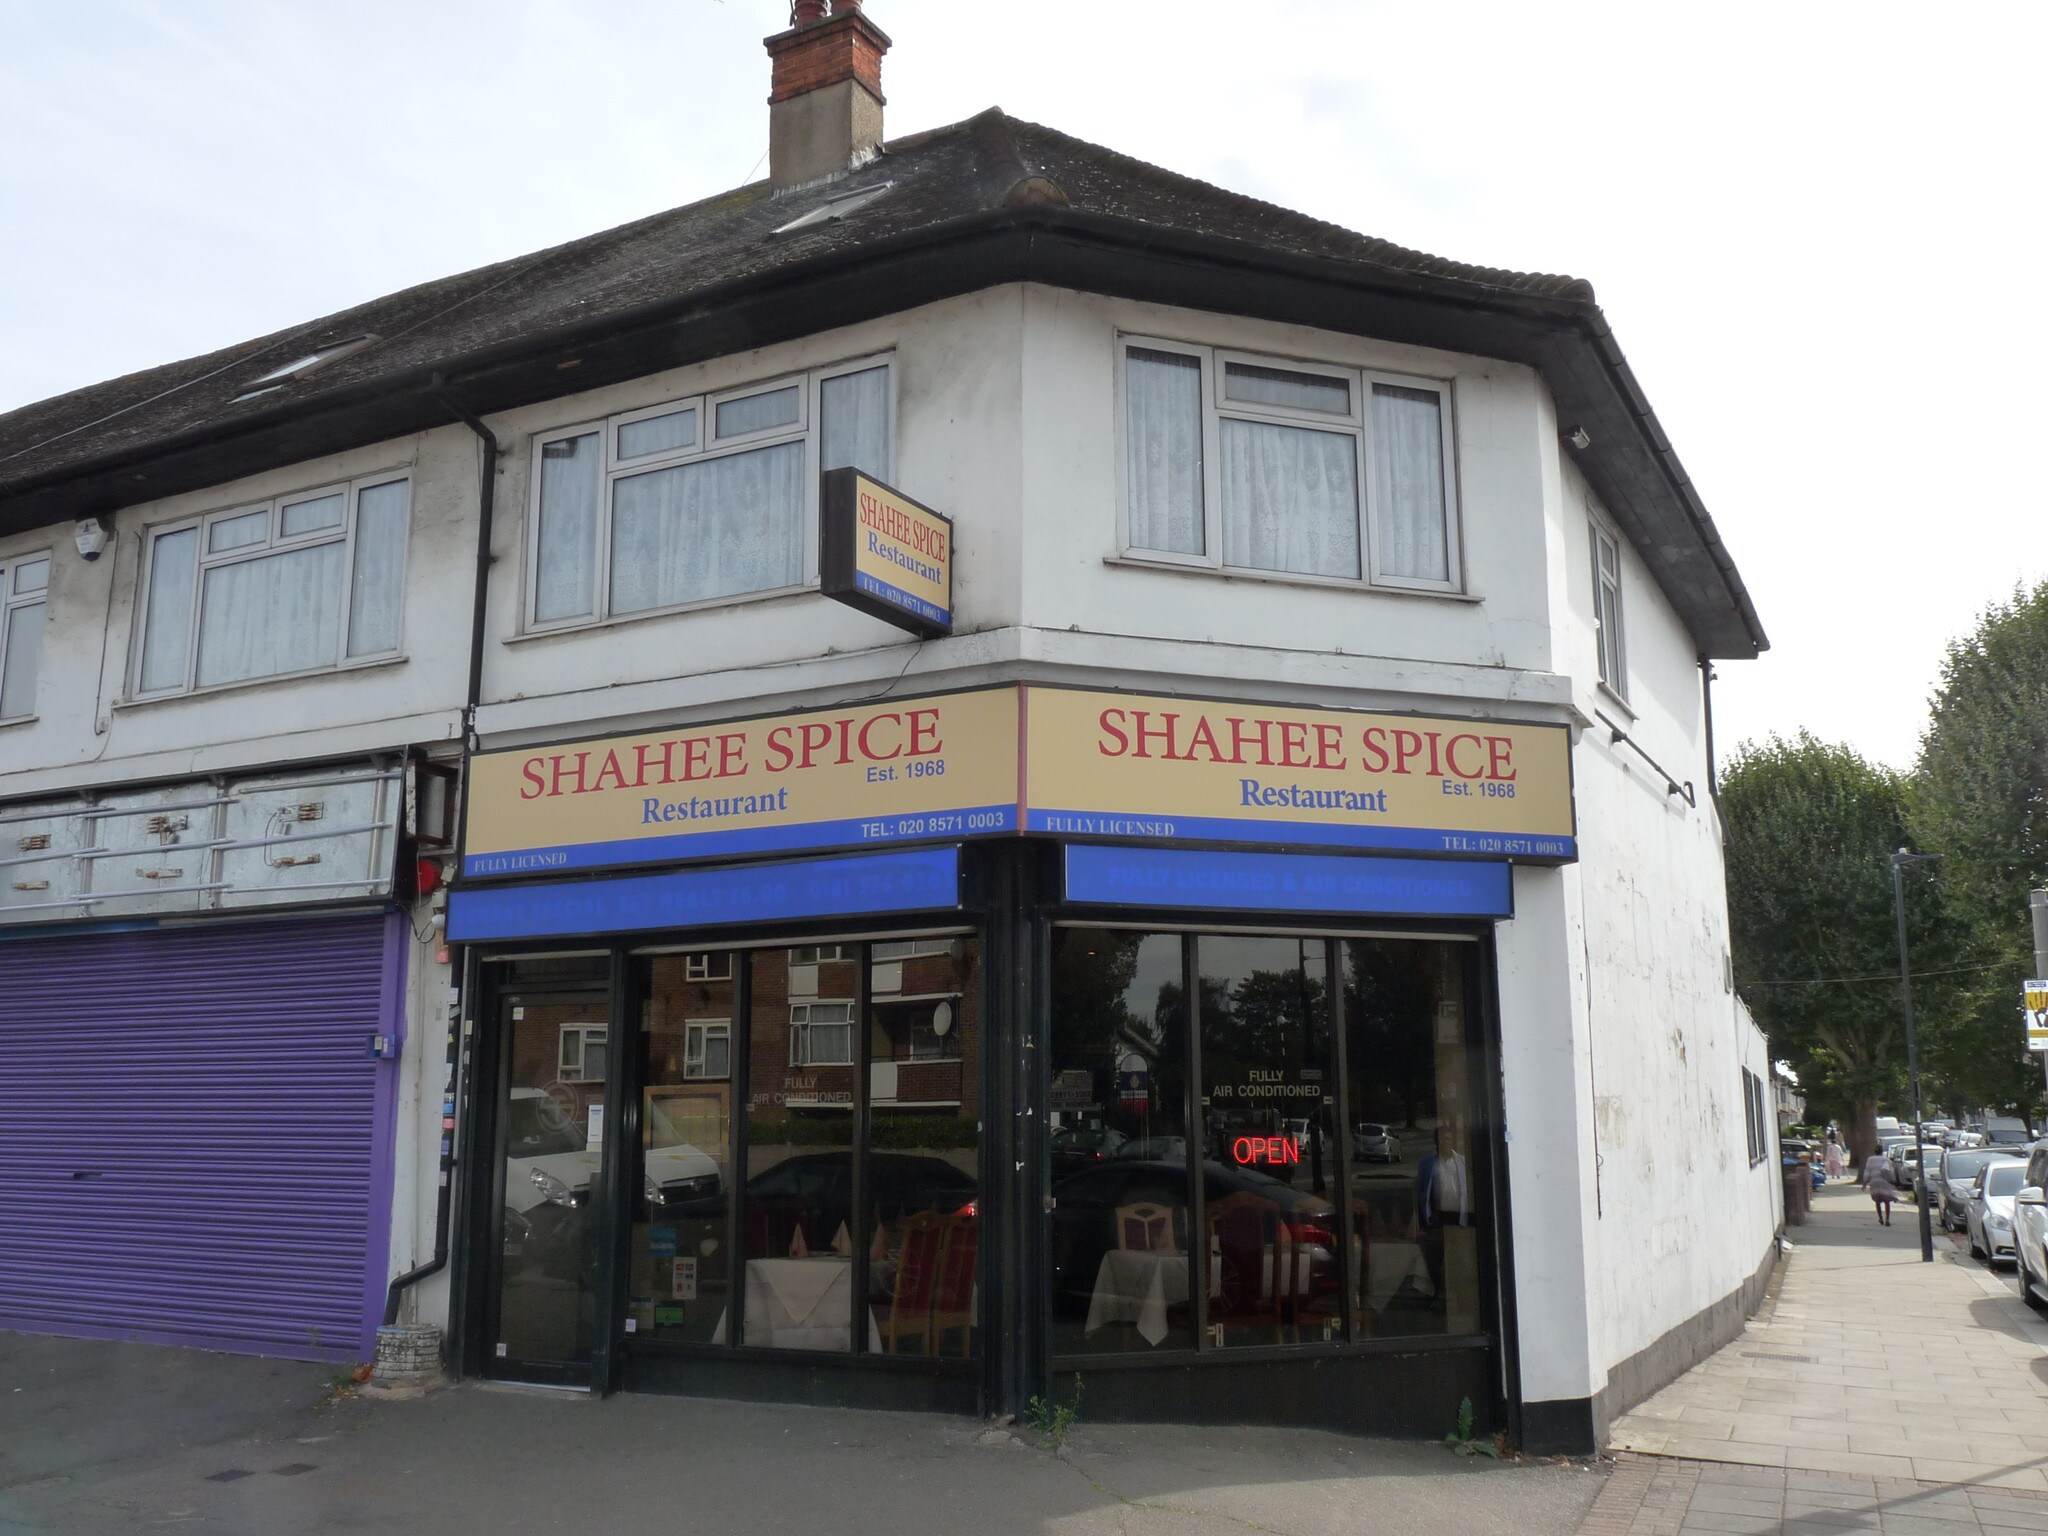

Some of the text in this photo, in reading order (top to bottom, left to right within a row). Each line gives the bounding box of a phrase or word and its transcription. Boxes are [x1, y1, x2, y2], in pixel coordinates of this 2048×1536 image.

[860, 492, 946, 564] SHAHEE SPICE
[867, 530, 942, 585] Restaurant
[886, 588, 901, 605] 020
[902, 596, 920, 614] 8571
[922, 605, 941, 622] 0003
[519, 707, 943, 801] SHAHEE SPICE
[1098, 707, 1518, 781] SHAHEE SPICE
[866, 758, 946, 784] Est. 1968
[1238, 778, 1388, 813] Restaurant
[1441, 778, 1516, 798] Est. 1968
[641, 785, 789, 825] Restaurant
[861, 812, 1004, 838] TEL: 020 8571 0003
[1046, 816, 1175, 837] FULLY LICENSED
[1442, 835, 1564, 855] TEL: 020 8571 0003
[474, 852, 568, 873] FULLY LICENSED
[785, 1077, 818, 1089] FULLY
[1249, 1070, 1284, 1082] FULLY
[752, 1091, 852, 1105] AIR CONDITIONED
[1213, 1085, 1320, 1097] AIR CONDITIONED
[1233, 1137, 1299, 1164] OPEN
